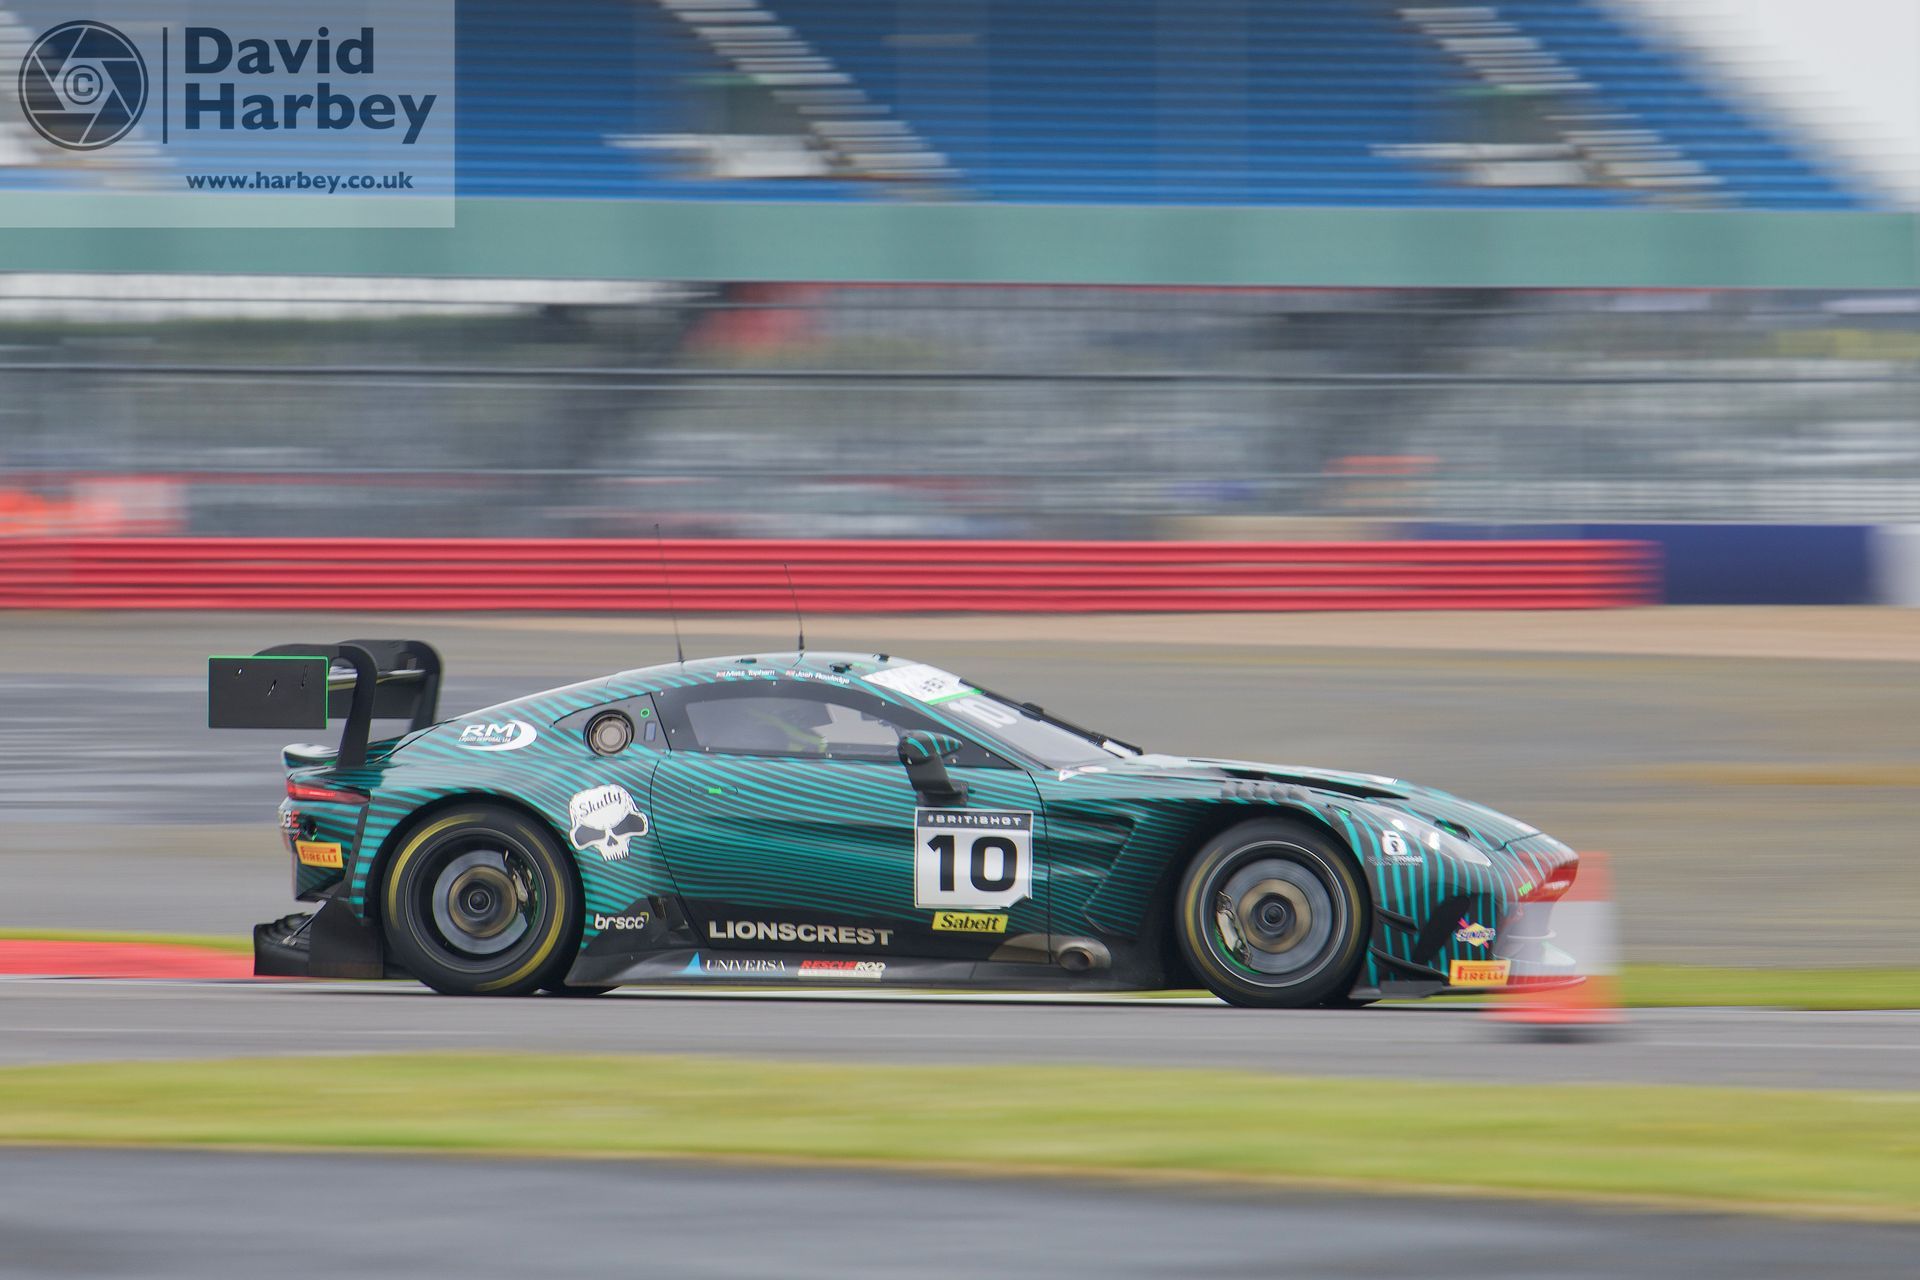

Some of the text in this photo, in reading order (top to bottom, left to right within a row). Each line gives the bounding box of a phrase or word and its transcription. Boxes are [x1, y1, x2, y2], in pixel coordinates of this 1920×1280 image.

[459, 723, 516, 738] RM
[926, 813, 1022, 827] #BRITISHGT
[300, 845, 338, 863] PIRELLI
[926, 834, 1018, 892] 10
[594, 912, 645, 930] brscc
[940, 912, 1000, 931] Sabelt
[708, 920, 894, 946] LIONSCREST
[704, 958, 787, 972] UNIVERSA
[1457, 965, 1506, 980] PIRELLI
